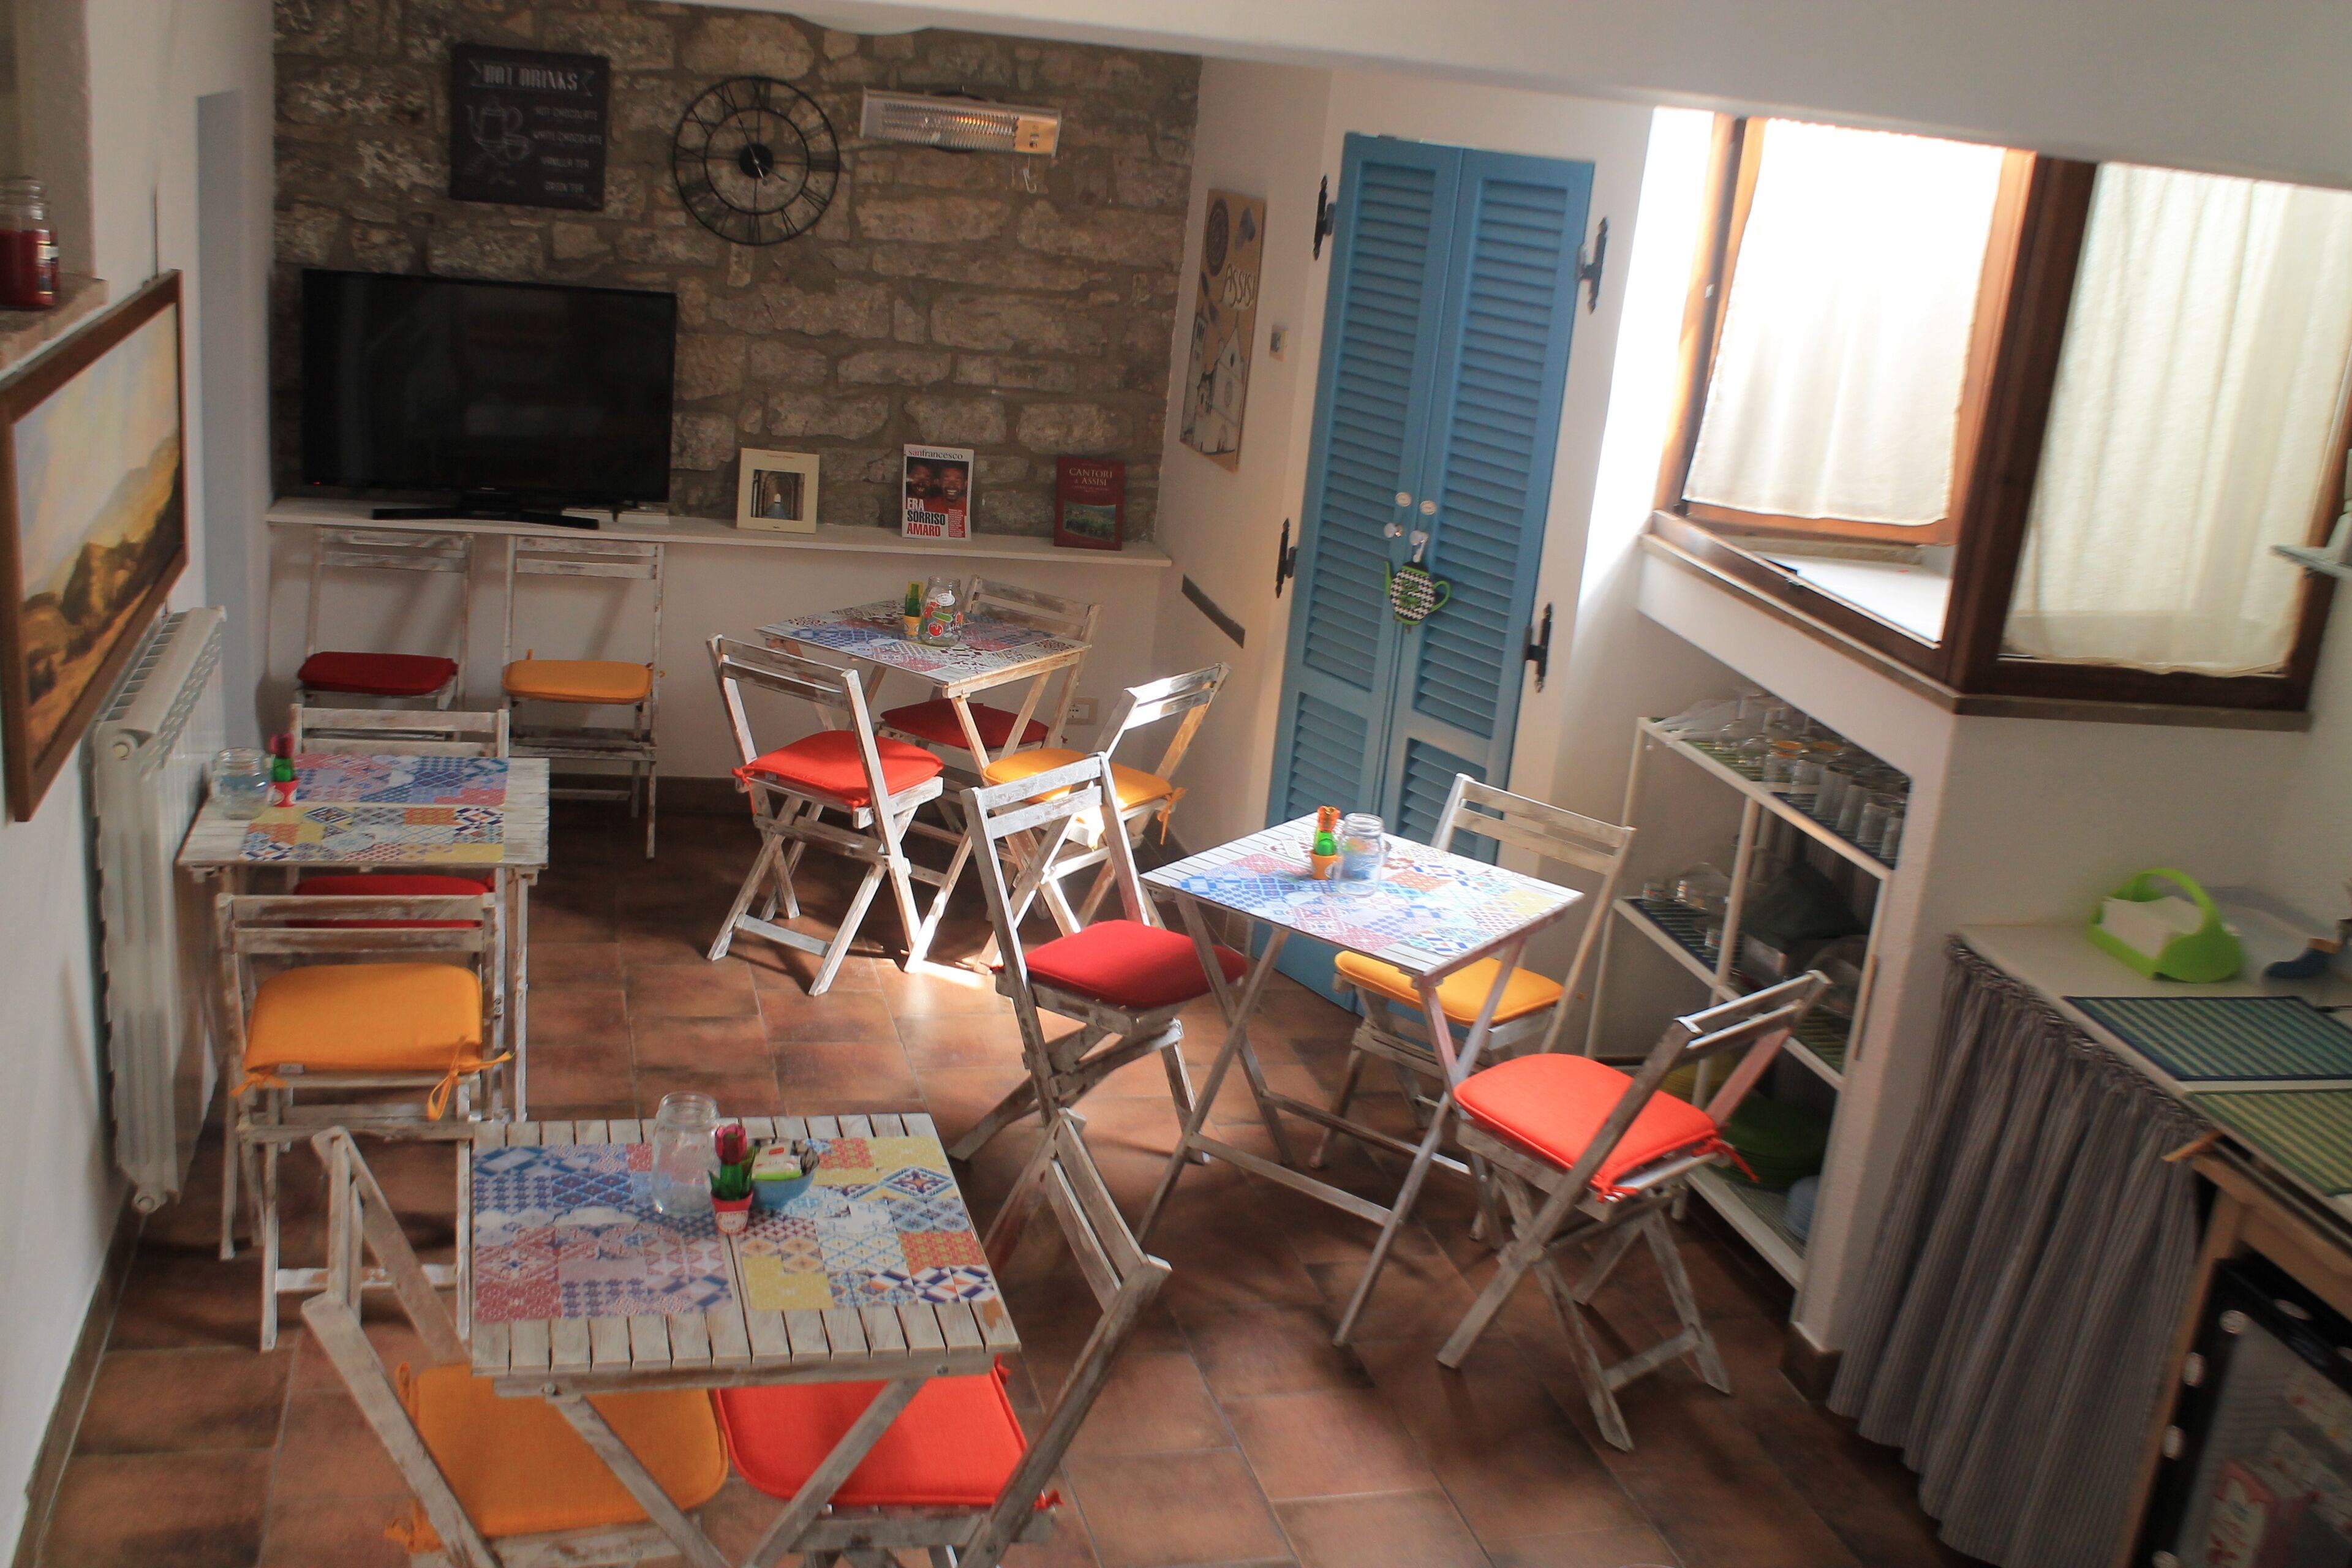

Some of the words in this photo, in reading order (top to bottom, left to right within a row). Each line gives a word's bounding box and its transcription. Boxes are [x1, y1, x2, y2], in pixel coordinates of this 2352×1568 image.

[519, 68, 578, 91] DRINKS
[1219, 263, 1256, 308] ASSISI
[908, 449, 963, 459] sanfrancesco
[1069, 467, 1112, 479] CANTORI
[1081, 477, 1106, 486] ASSISI
[907, 497, 925, 511] ERA
[907, 509, 946, 525] SORRISO
[907, 522, 941, 537] AMARO
